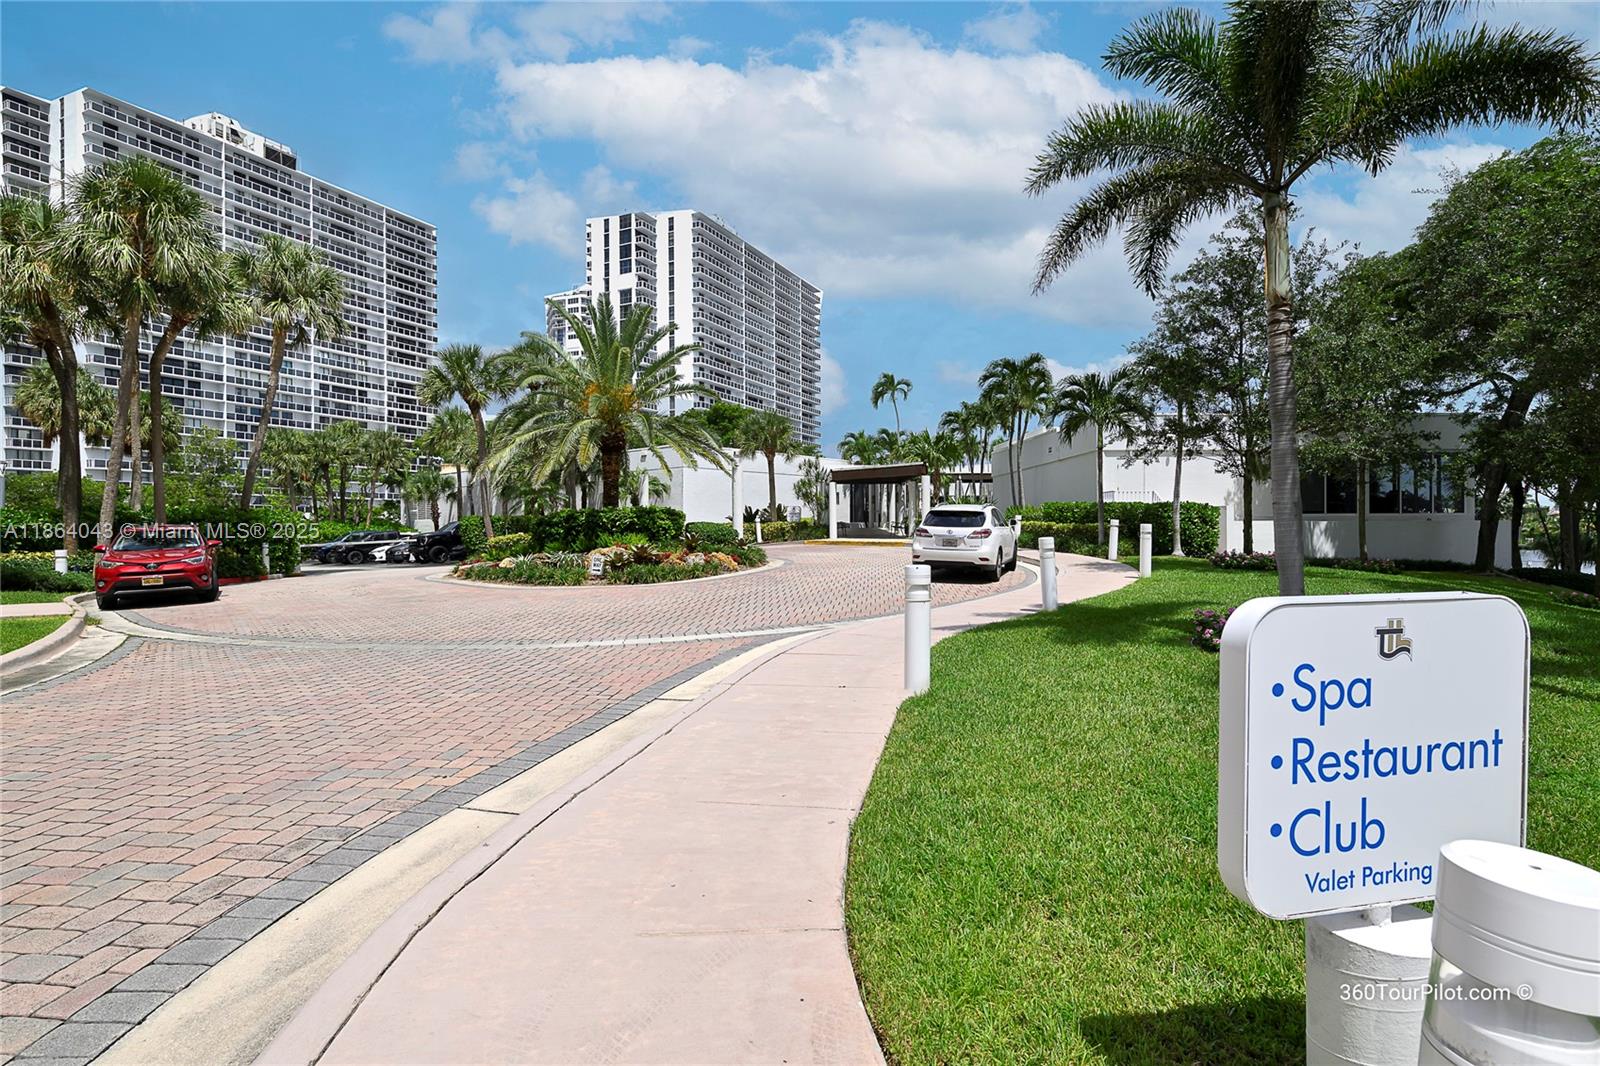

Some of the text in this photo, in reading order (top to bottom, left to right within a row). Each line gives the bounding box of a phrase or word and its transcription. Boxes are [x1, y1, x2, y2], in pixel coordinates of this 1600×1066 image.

[1291, 663, 1372, 726] Spa
[1291, 729, 1503, 785] Restaurant
[1289, 797, 1385, 857] Club
[1305, 861, 1432, 893] Valet Parking
